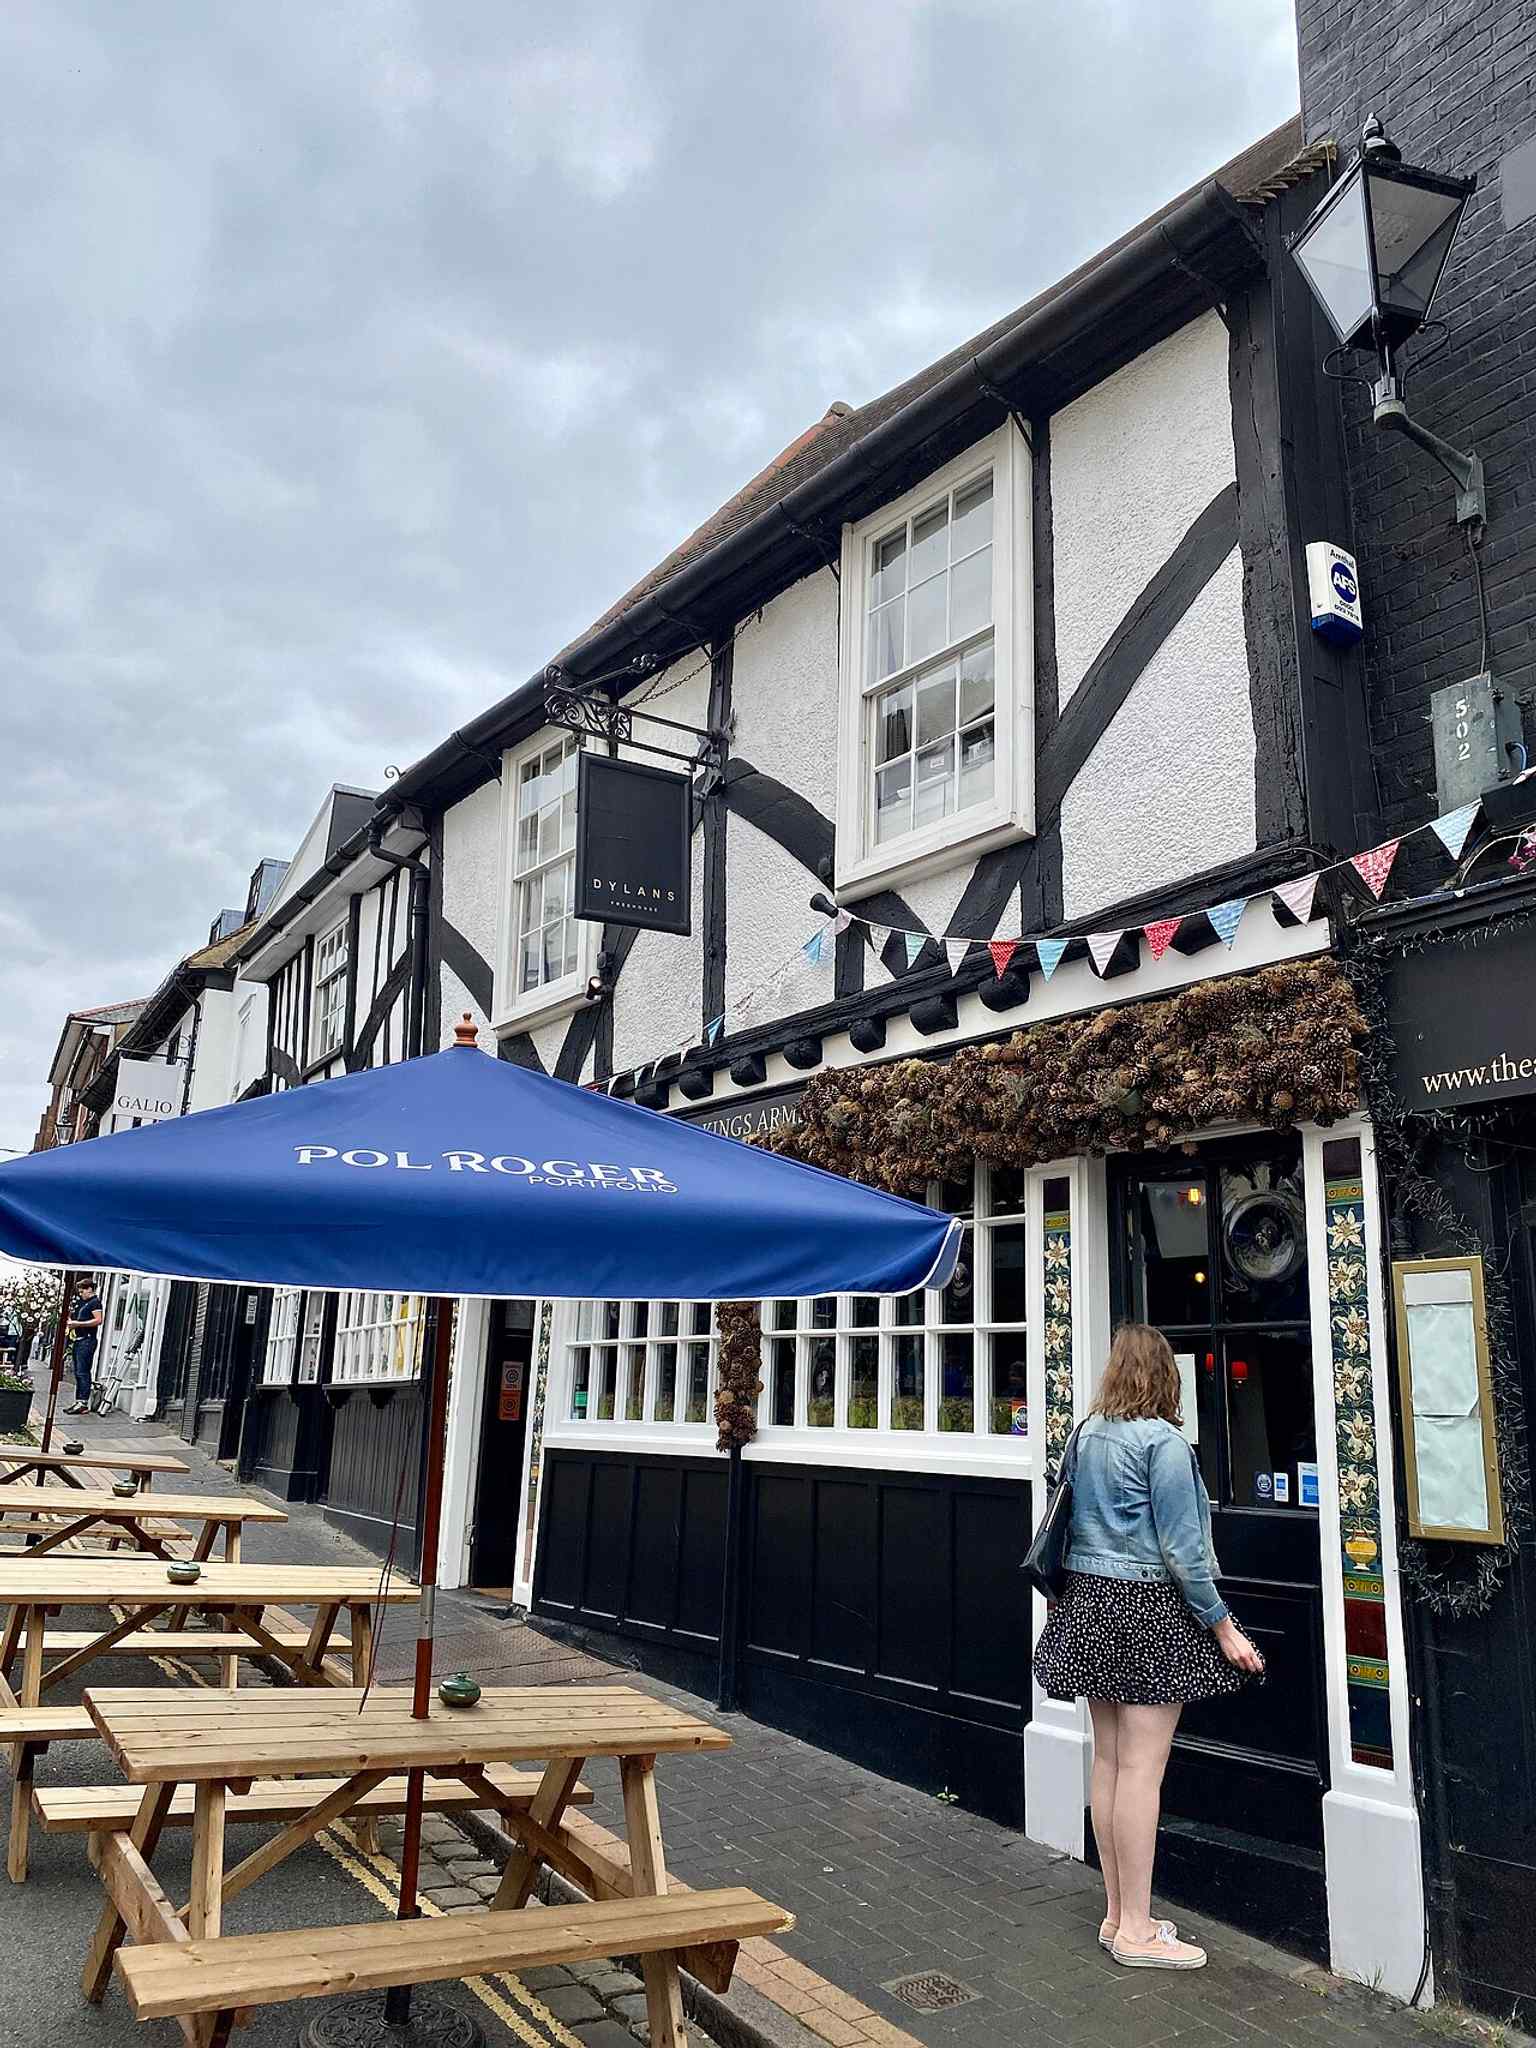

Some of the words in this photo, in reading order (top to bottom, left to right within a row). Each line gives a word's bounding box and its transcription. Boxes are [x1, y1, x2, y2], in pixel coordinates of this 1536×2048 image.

[1333, 571, 1356, 596] AFS
[592, 878, 675, 901] DYLANS
[1421, 1052, 1536, 1094] www.the
[117, 1095, 172, 1114] GALIO
[757, 1105, 803, 1133] ARM
[294, 1145, 433, 1169] POL
[441, 1150, 675, 1185] ROGER
[528, 1175, 679, 1194] PORTFOLIO
